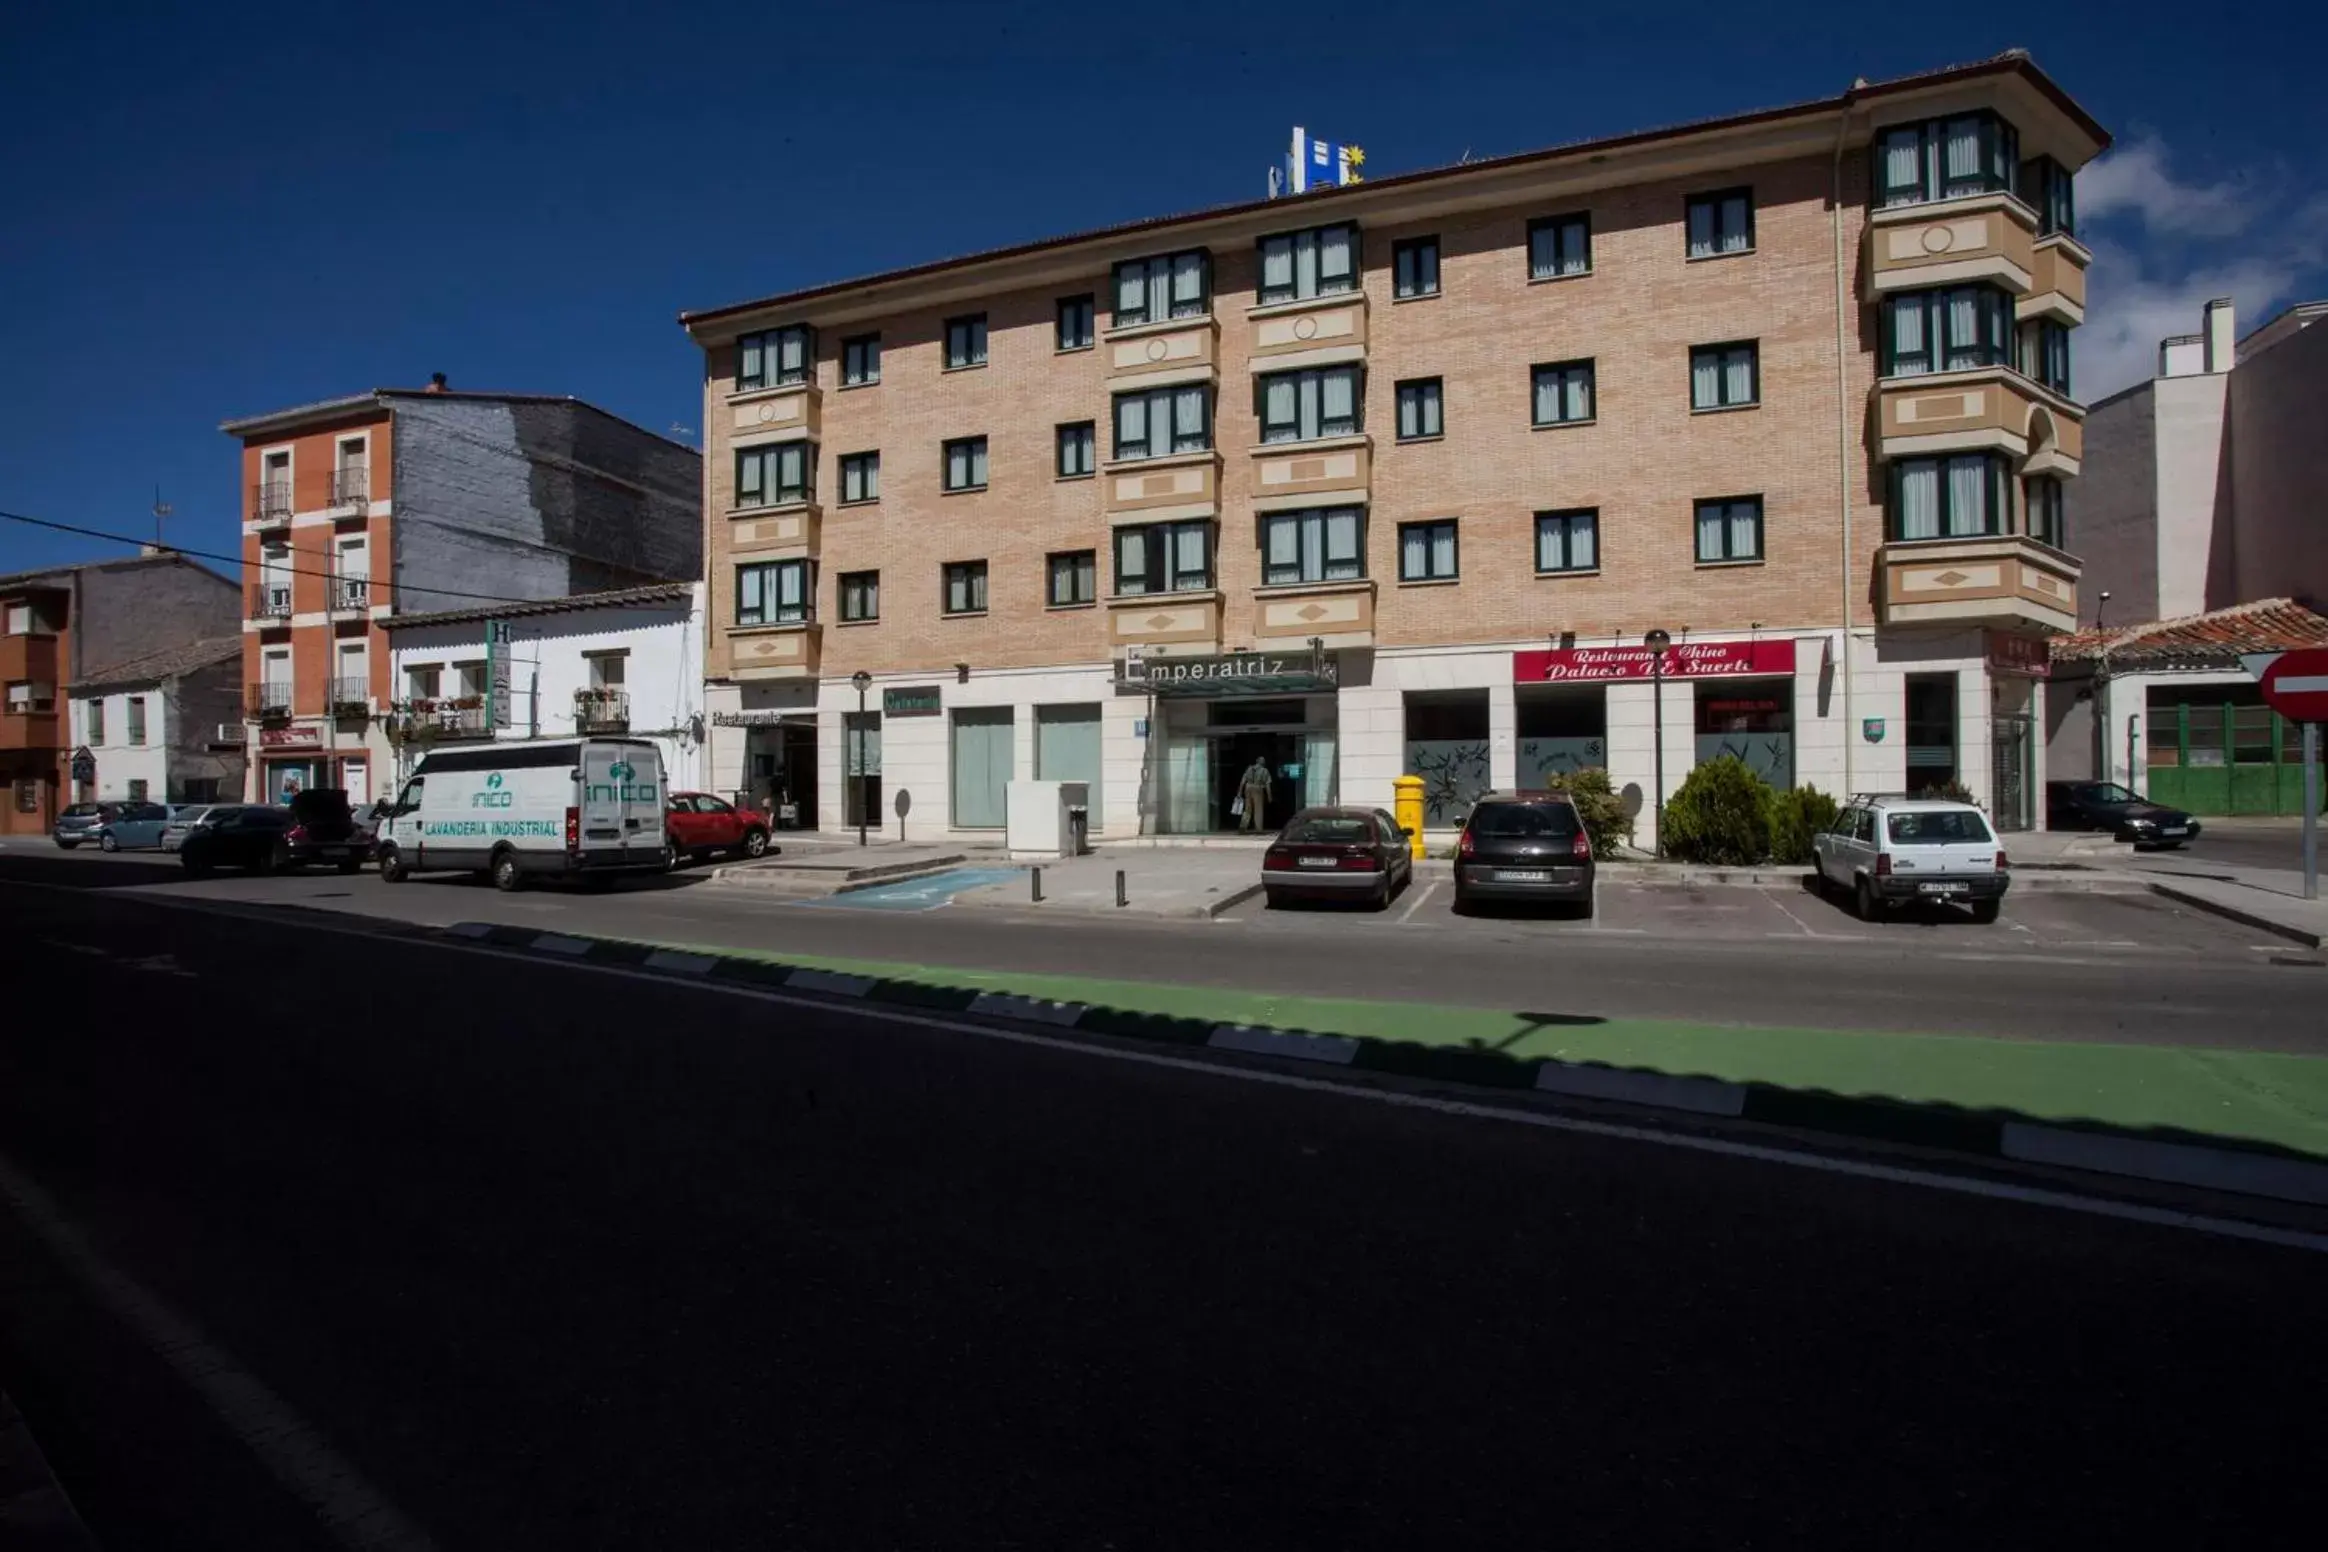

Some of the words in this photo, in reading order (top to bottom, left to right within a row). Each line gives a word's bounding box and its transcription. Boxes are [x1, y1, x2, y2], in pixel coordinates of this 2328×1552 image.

[494, 623, 509, 643] H
[1679, 645, 1727, 659] Chino
[1125, 644, 1284, 684] Emperatriz
